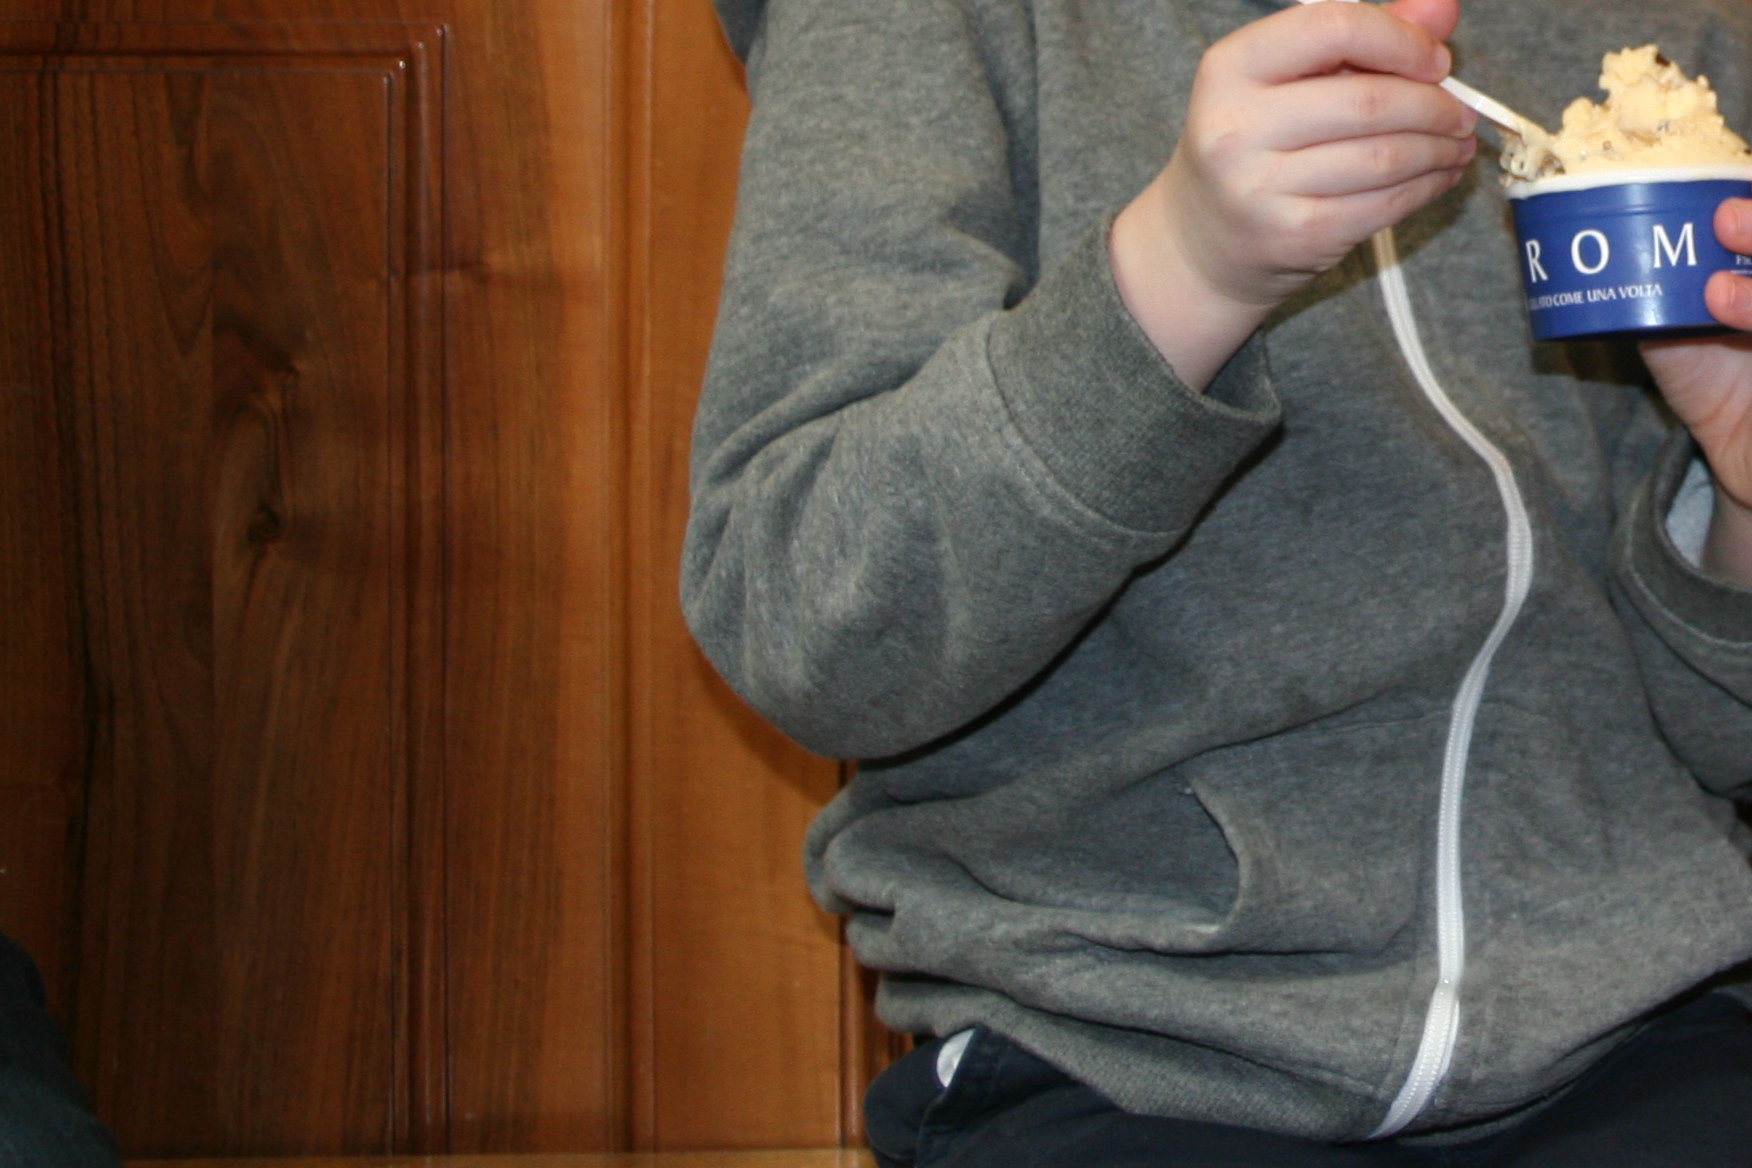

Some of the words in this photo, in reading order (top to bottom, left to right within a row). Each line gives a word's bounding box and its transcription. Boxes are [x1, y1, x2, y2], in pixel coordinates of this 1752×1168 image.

[1552, 291, 1584, 307] COME
[1586, 288, 1616, 303] UNA
[1618, 284, 1663, 299] VOLTA
